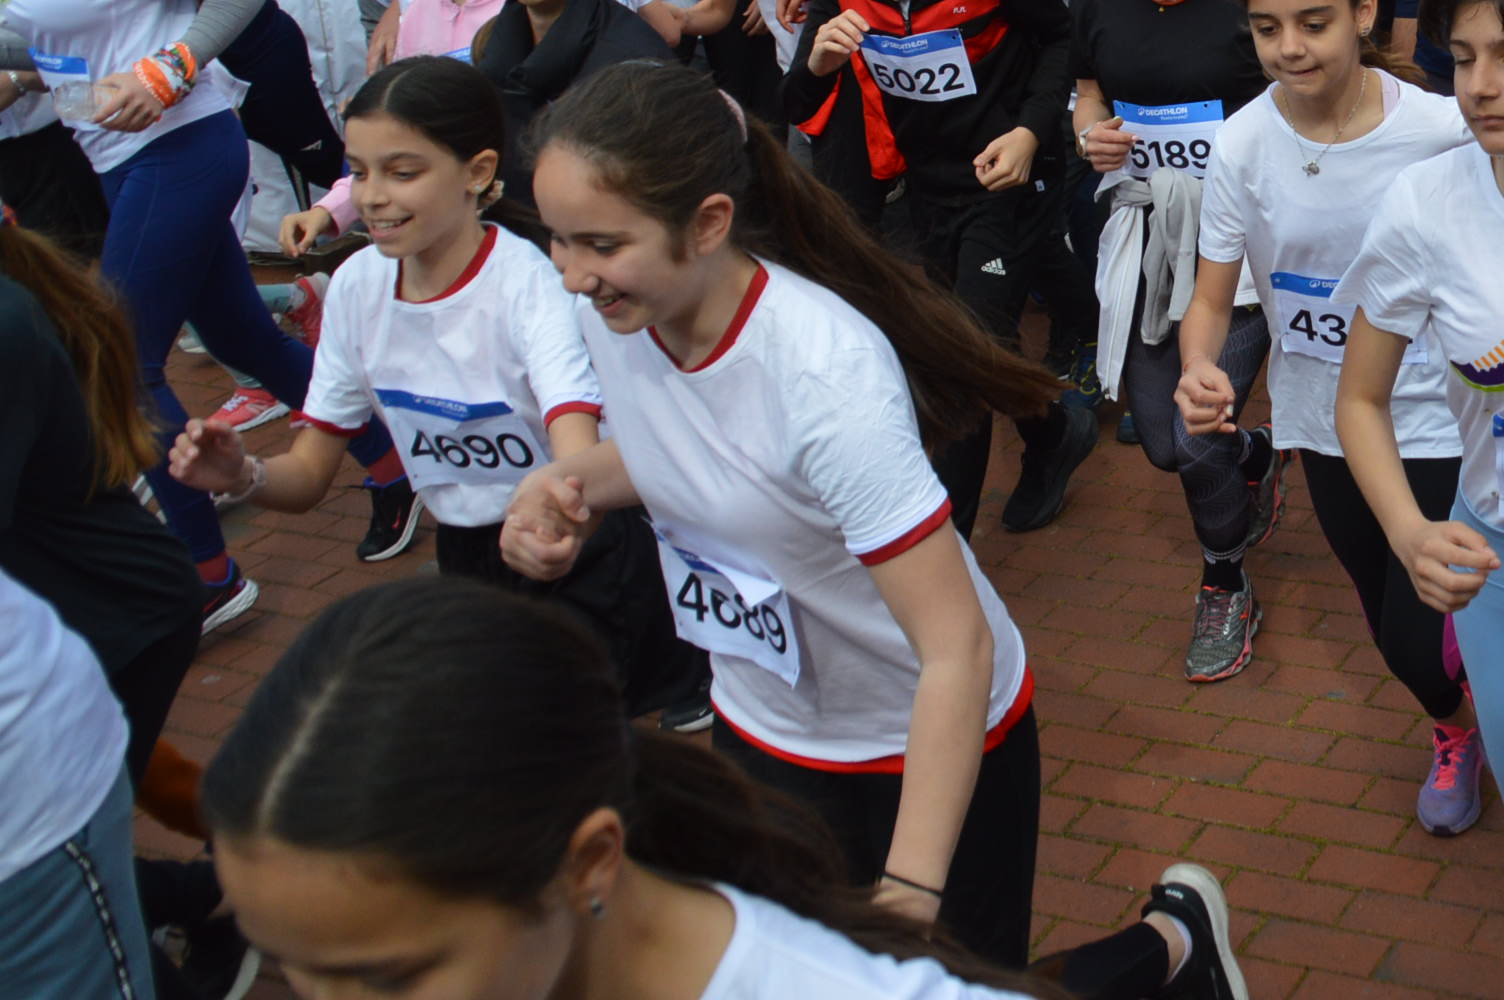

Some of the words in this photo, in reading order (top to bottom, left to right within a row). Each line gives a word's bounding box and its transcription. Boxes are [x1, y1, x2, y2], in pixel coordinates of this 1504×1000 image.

[873, 63, 965, 95] 5022
[1145, 106, 1188, 116] DECATHLON
[1131, 139, 1211, 169] 5189
[1289, 309, 1348, 347] 43
[410, 429, 534, 469] 4690
